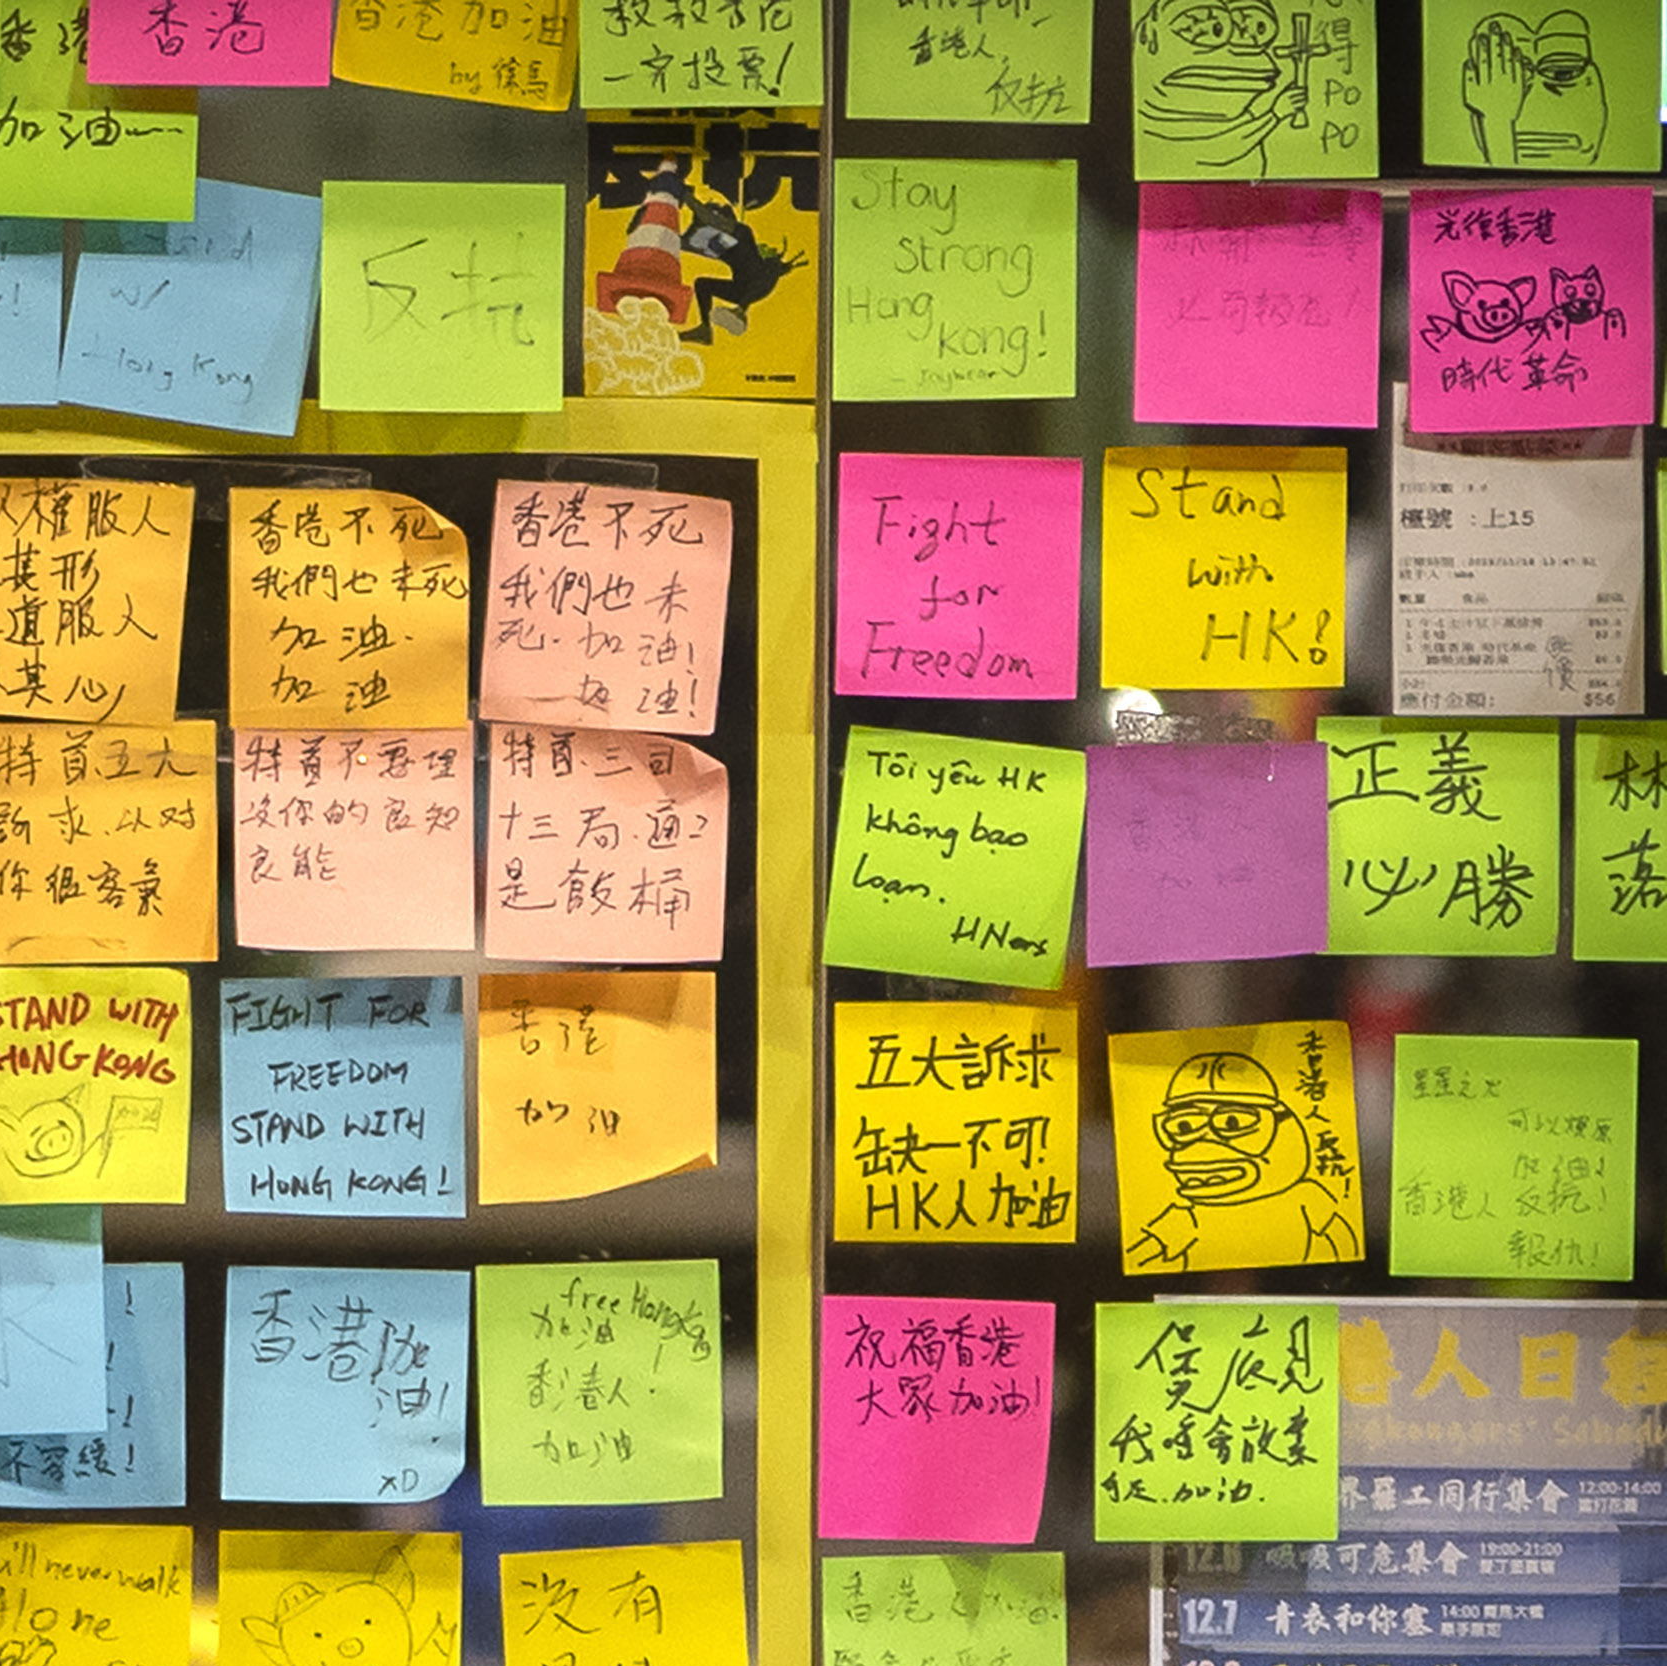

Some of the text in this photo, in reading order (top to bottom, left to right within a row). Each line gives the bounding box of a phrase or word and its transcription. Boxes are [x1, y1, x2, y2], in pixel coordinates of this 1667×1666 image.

[850, 167, 958, 232] Stay
[895, 236, 1034, 295] Strong
[848, 292, 932, 342] Hong
[1130, 466, 1286, 522] Stand
[872, 496, 1006, 563] Fight
[1186, 555, 1273, 589] with
[919, 576, 1001, 621] for
[860, 619, 1034, 682] Freedom
[867, 751, 915, 782] Tôi
[998, 765, 1047, 793] HK
[1329, 731, 1502, 821] 正義
[1343, 845, 1535, 930] 必勝
[108, 1002, 181, 1043] WITH
[227, 994, 431, 1034] FIGHT FOR
[93, 1045, 175, 1084] KONG
[269, 1060, 409, 1093] FREEDOM
[856, 1033, 1060, 1091] 五大訴求
[232, 1108, 426, 1144] STAND WITH
[251, 1169, 332, 1200] HONG
[1184, 1599, 1237, 1634] 12.7
